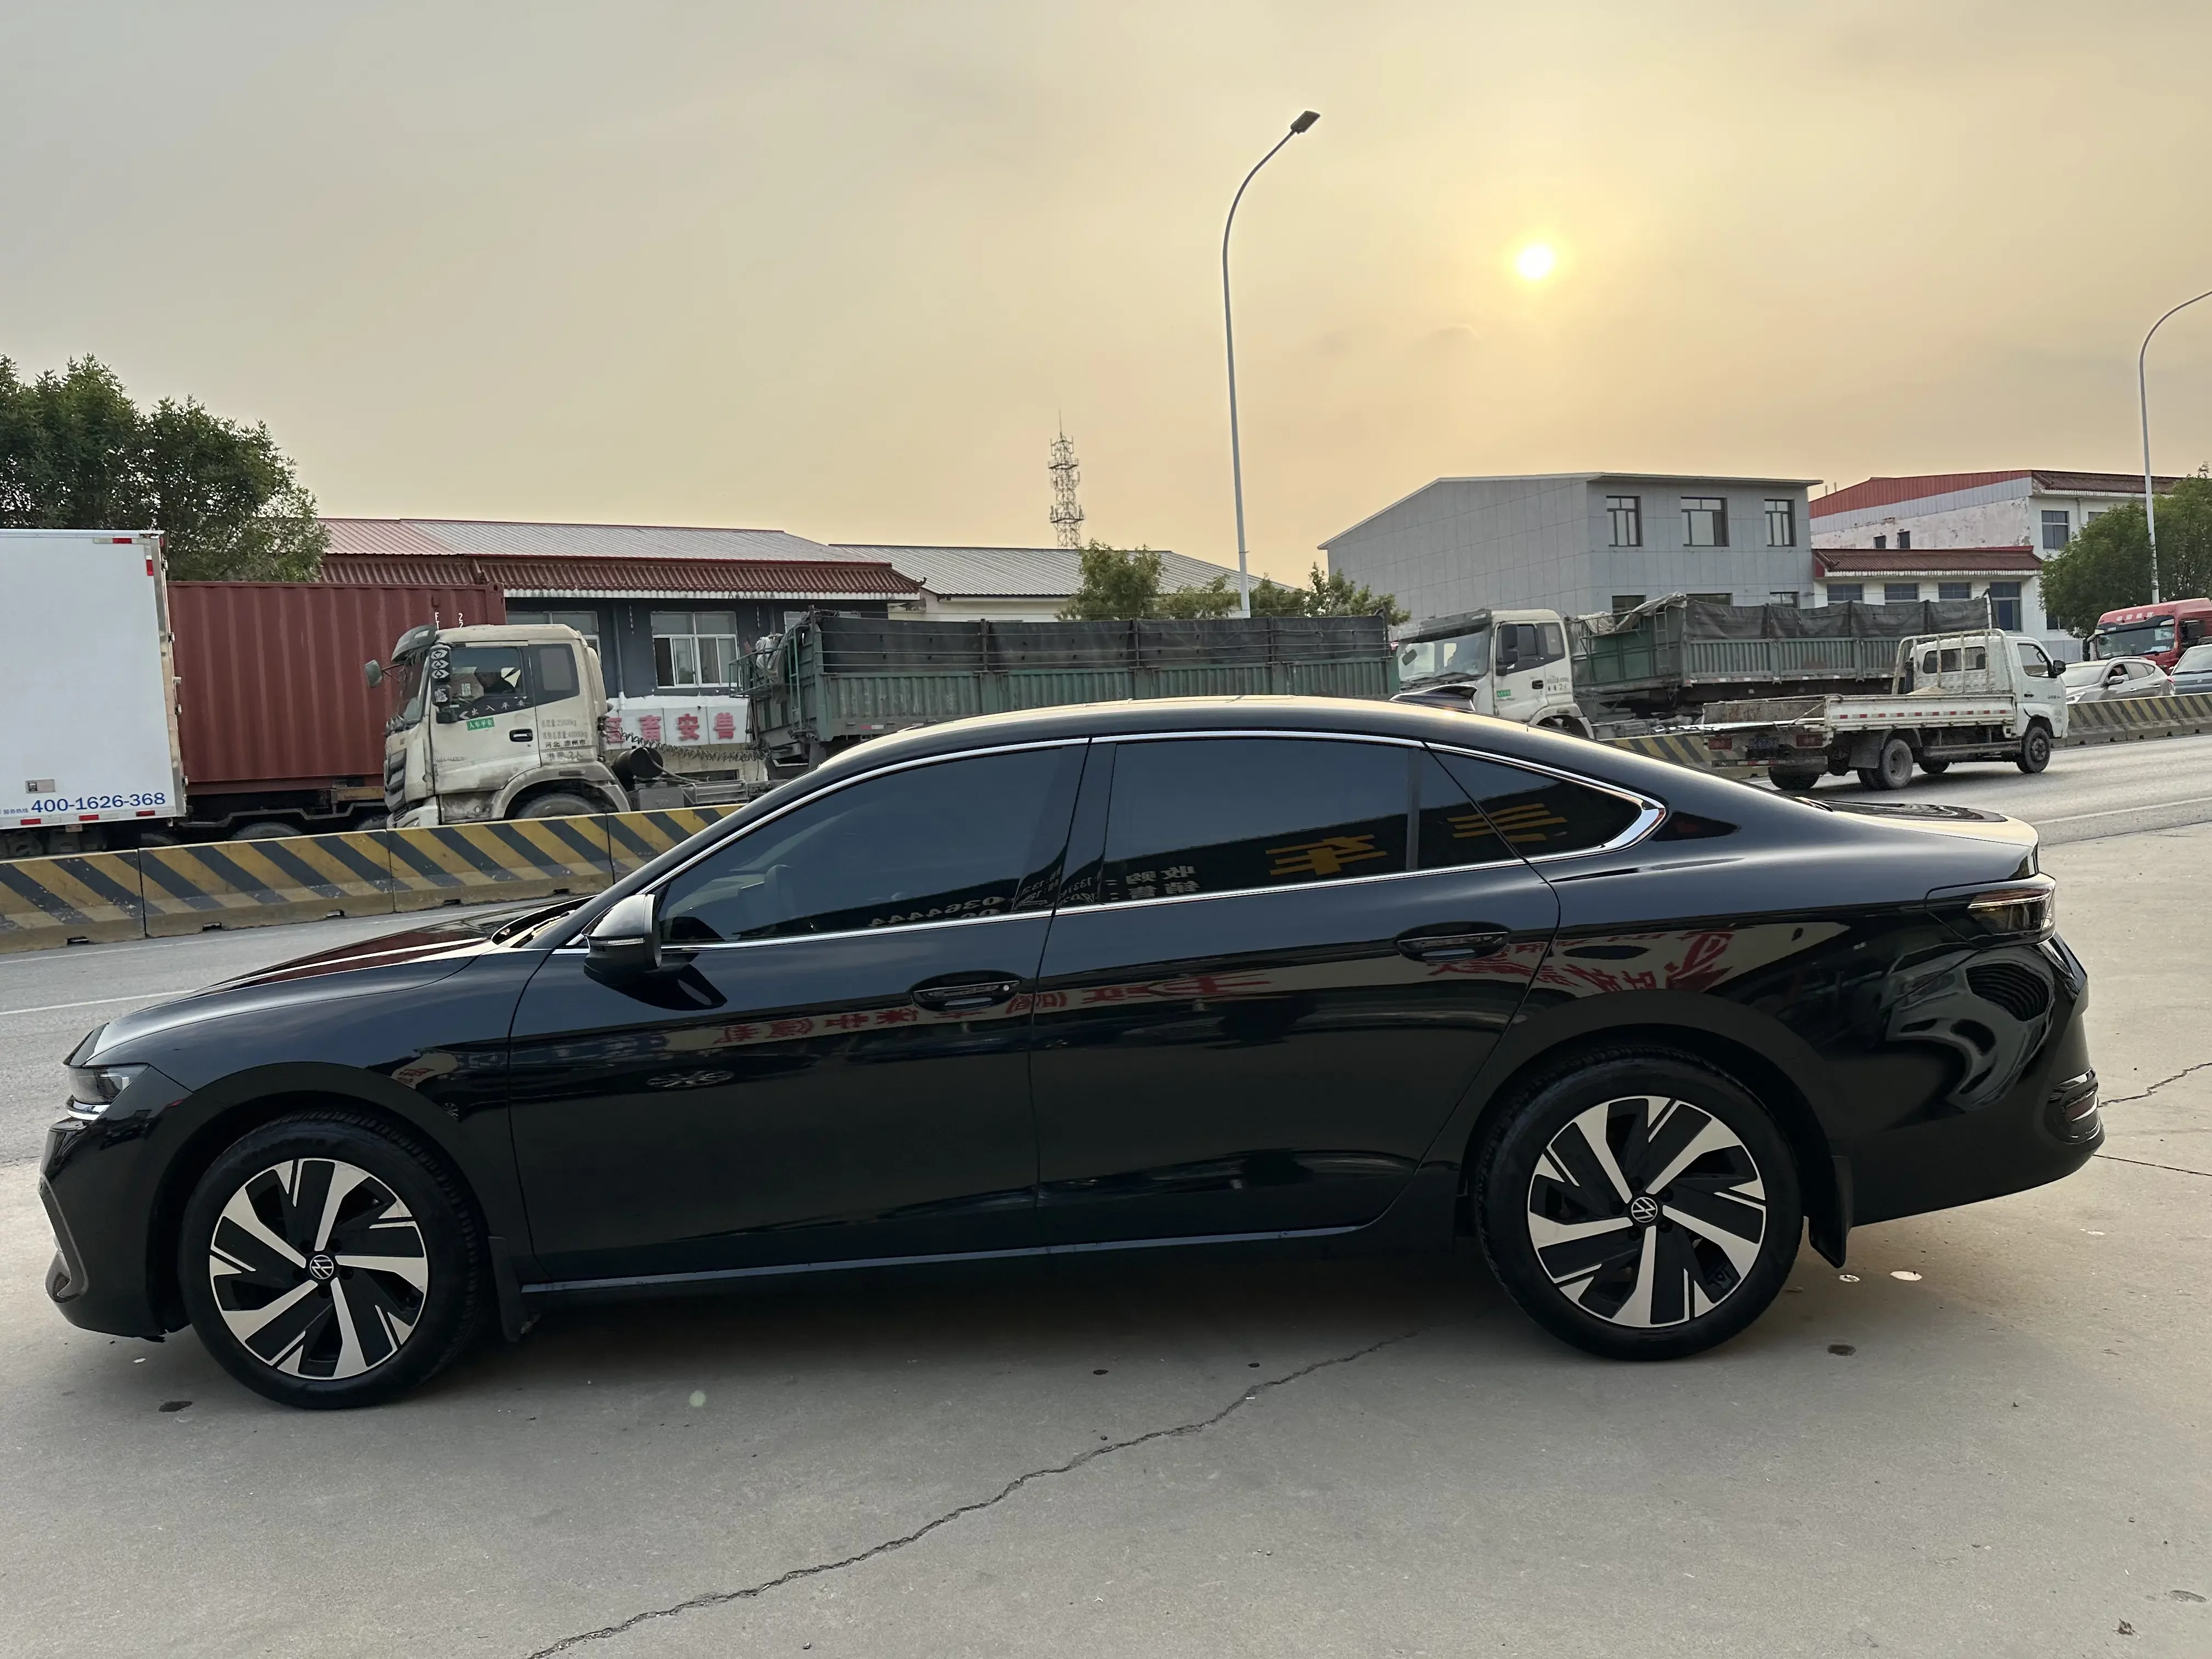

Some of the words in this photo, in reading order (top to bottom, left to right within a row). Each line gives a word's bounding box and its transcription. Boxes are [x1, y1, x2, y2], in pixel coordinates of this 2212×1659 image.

[471, 699, 526, 716] 出入平安
[31, 792, 166, 813] 400-1626-368
